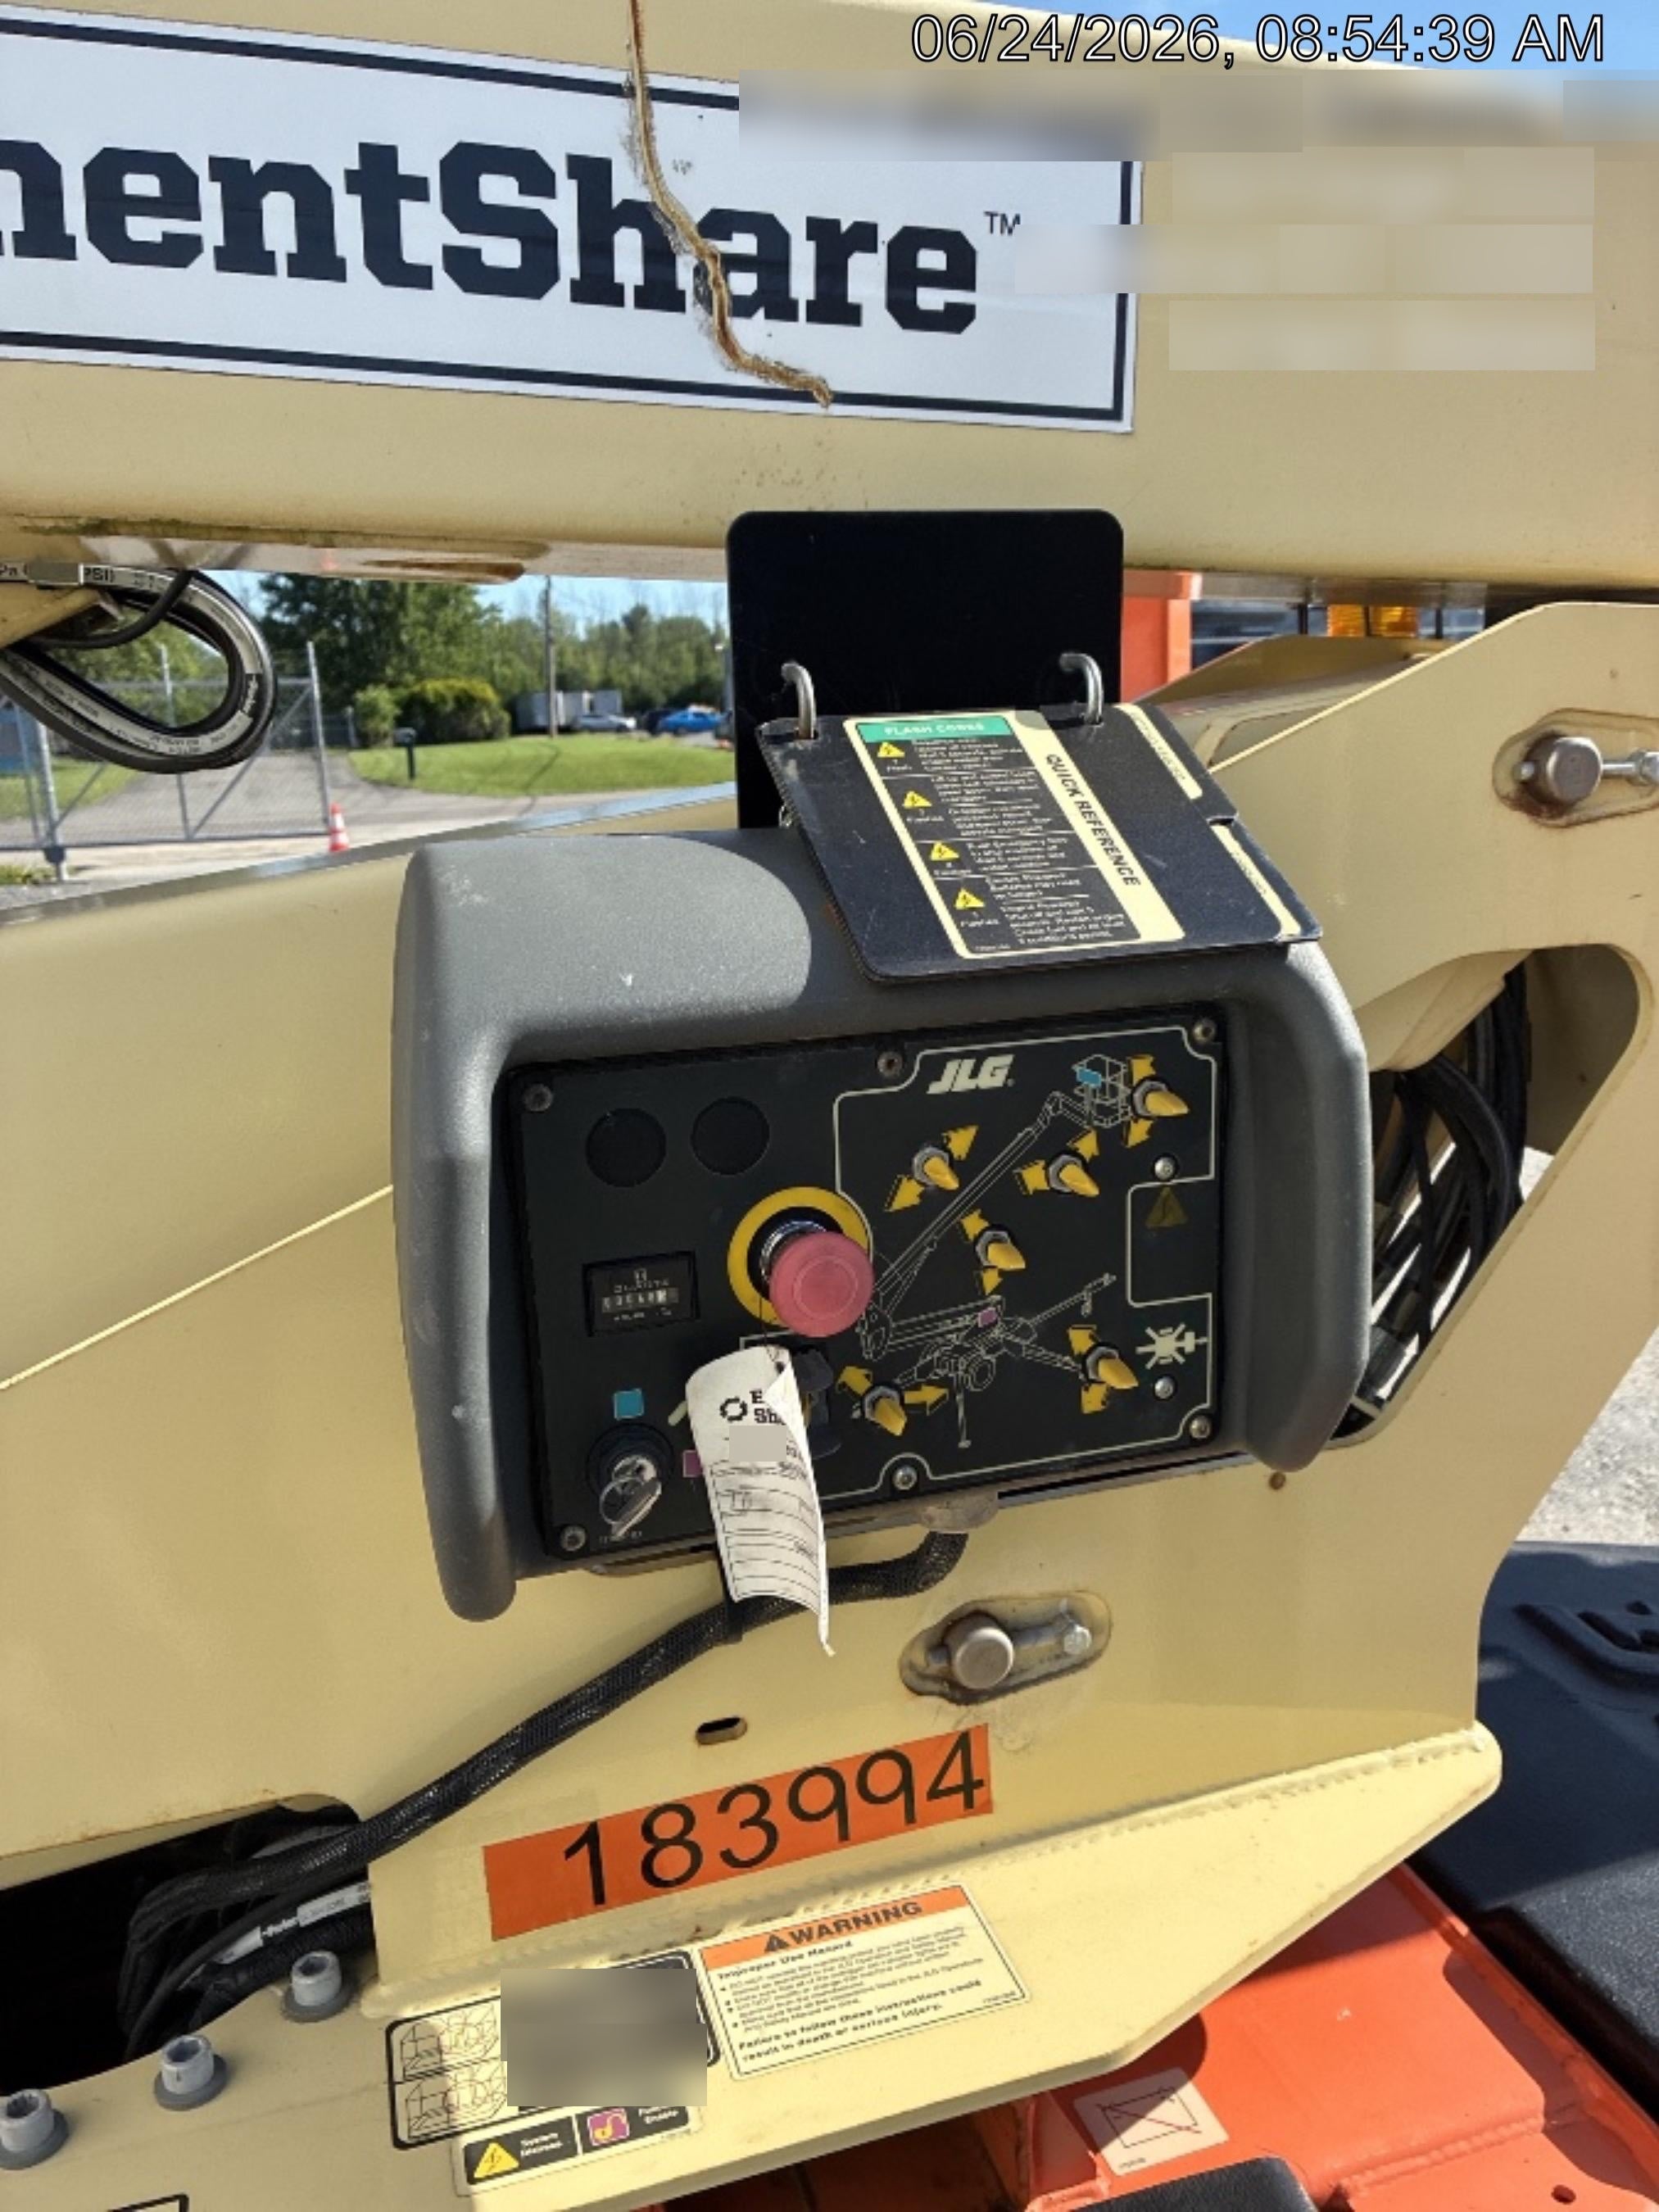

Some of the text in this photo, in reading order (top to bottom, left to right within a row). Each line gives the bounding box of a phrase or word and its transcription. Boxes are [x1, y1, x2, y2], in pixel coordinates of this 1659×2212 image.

[1045, 754, 1141, 886] QUICK REFERENCE
[926, 1054, 1016, 1095] JLG
[564, 1729, 985, 1906] 183994
[789, 1900, 922, 1947] WARNING
